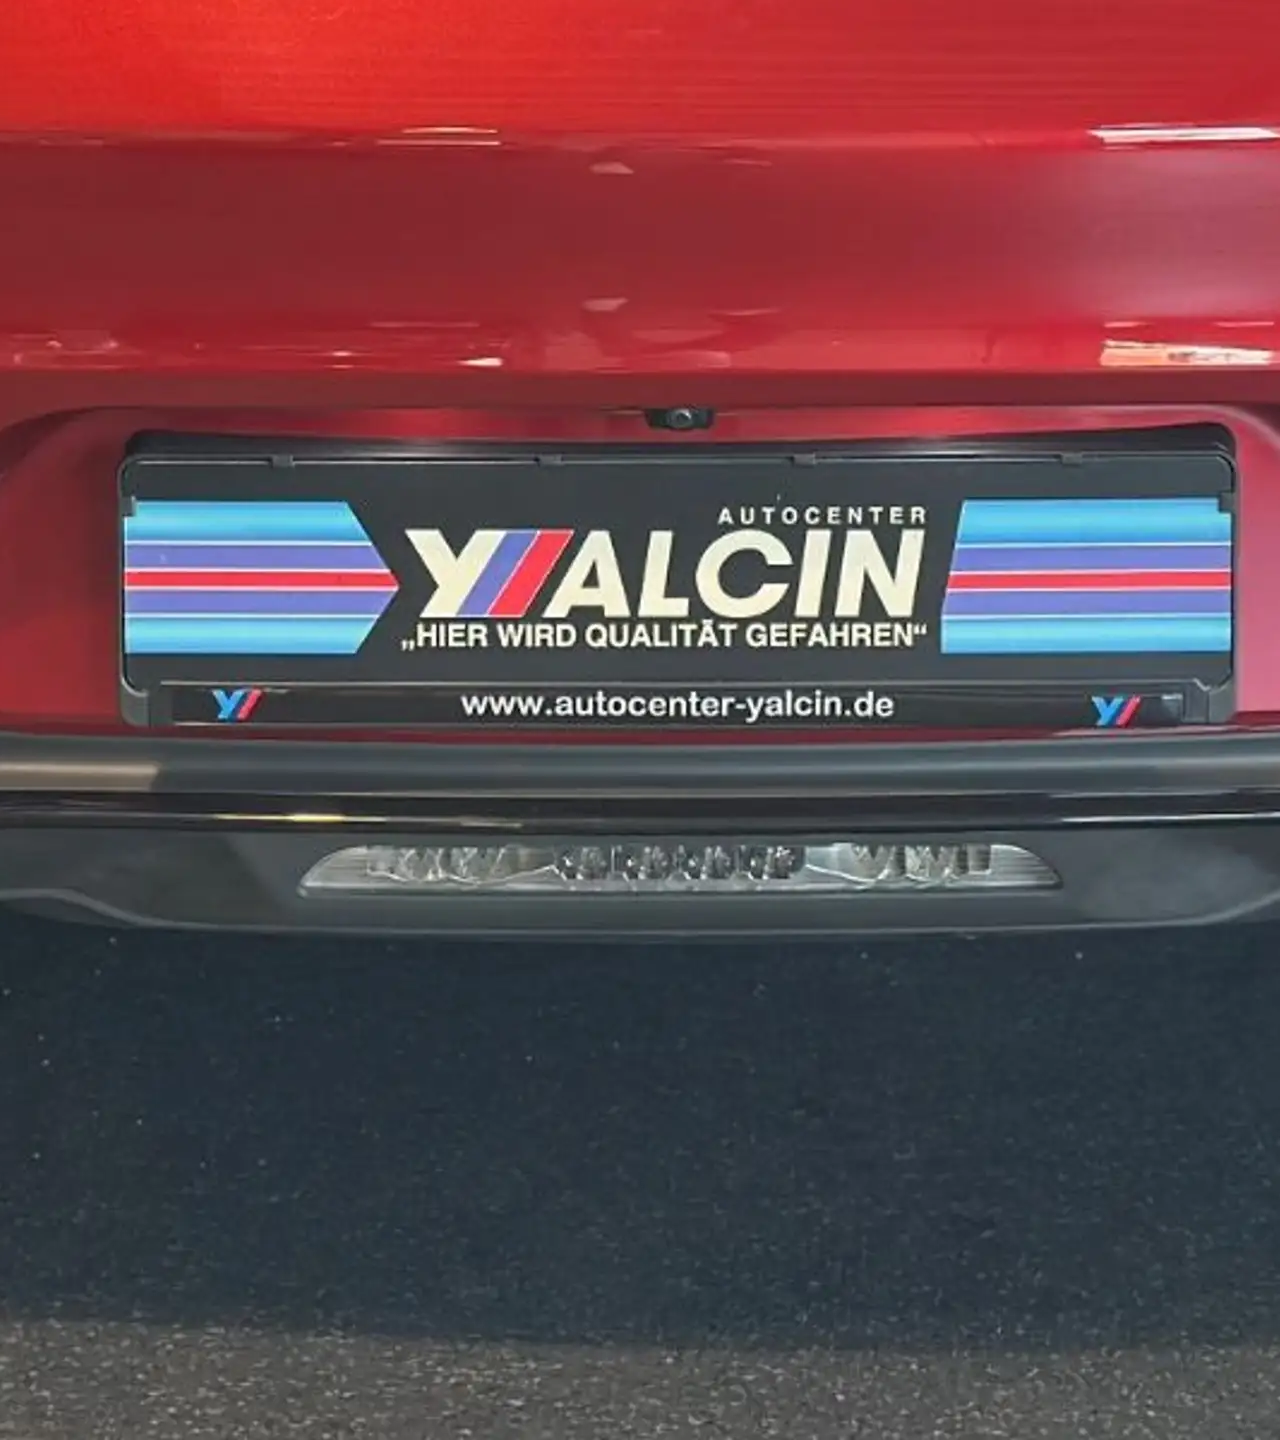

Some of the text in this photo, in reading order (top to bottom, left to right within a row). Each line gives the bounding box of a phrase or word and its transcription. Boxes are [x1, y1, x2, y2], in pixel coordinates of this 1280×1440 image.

[718, 506, 927, 525] AUTOCENTER
[496, 623, 575, 648] WIRD
[585, 618, 738, 649] QUALITÄT
[461, 690, 894, 723] www.autocenter-yalcin.de
